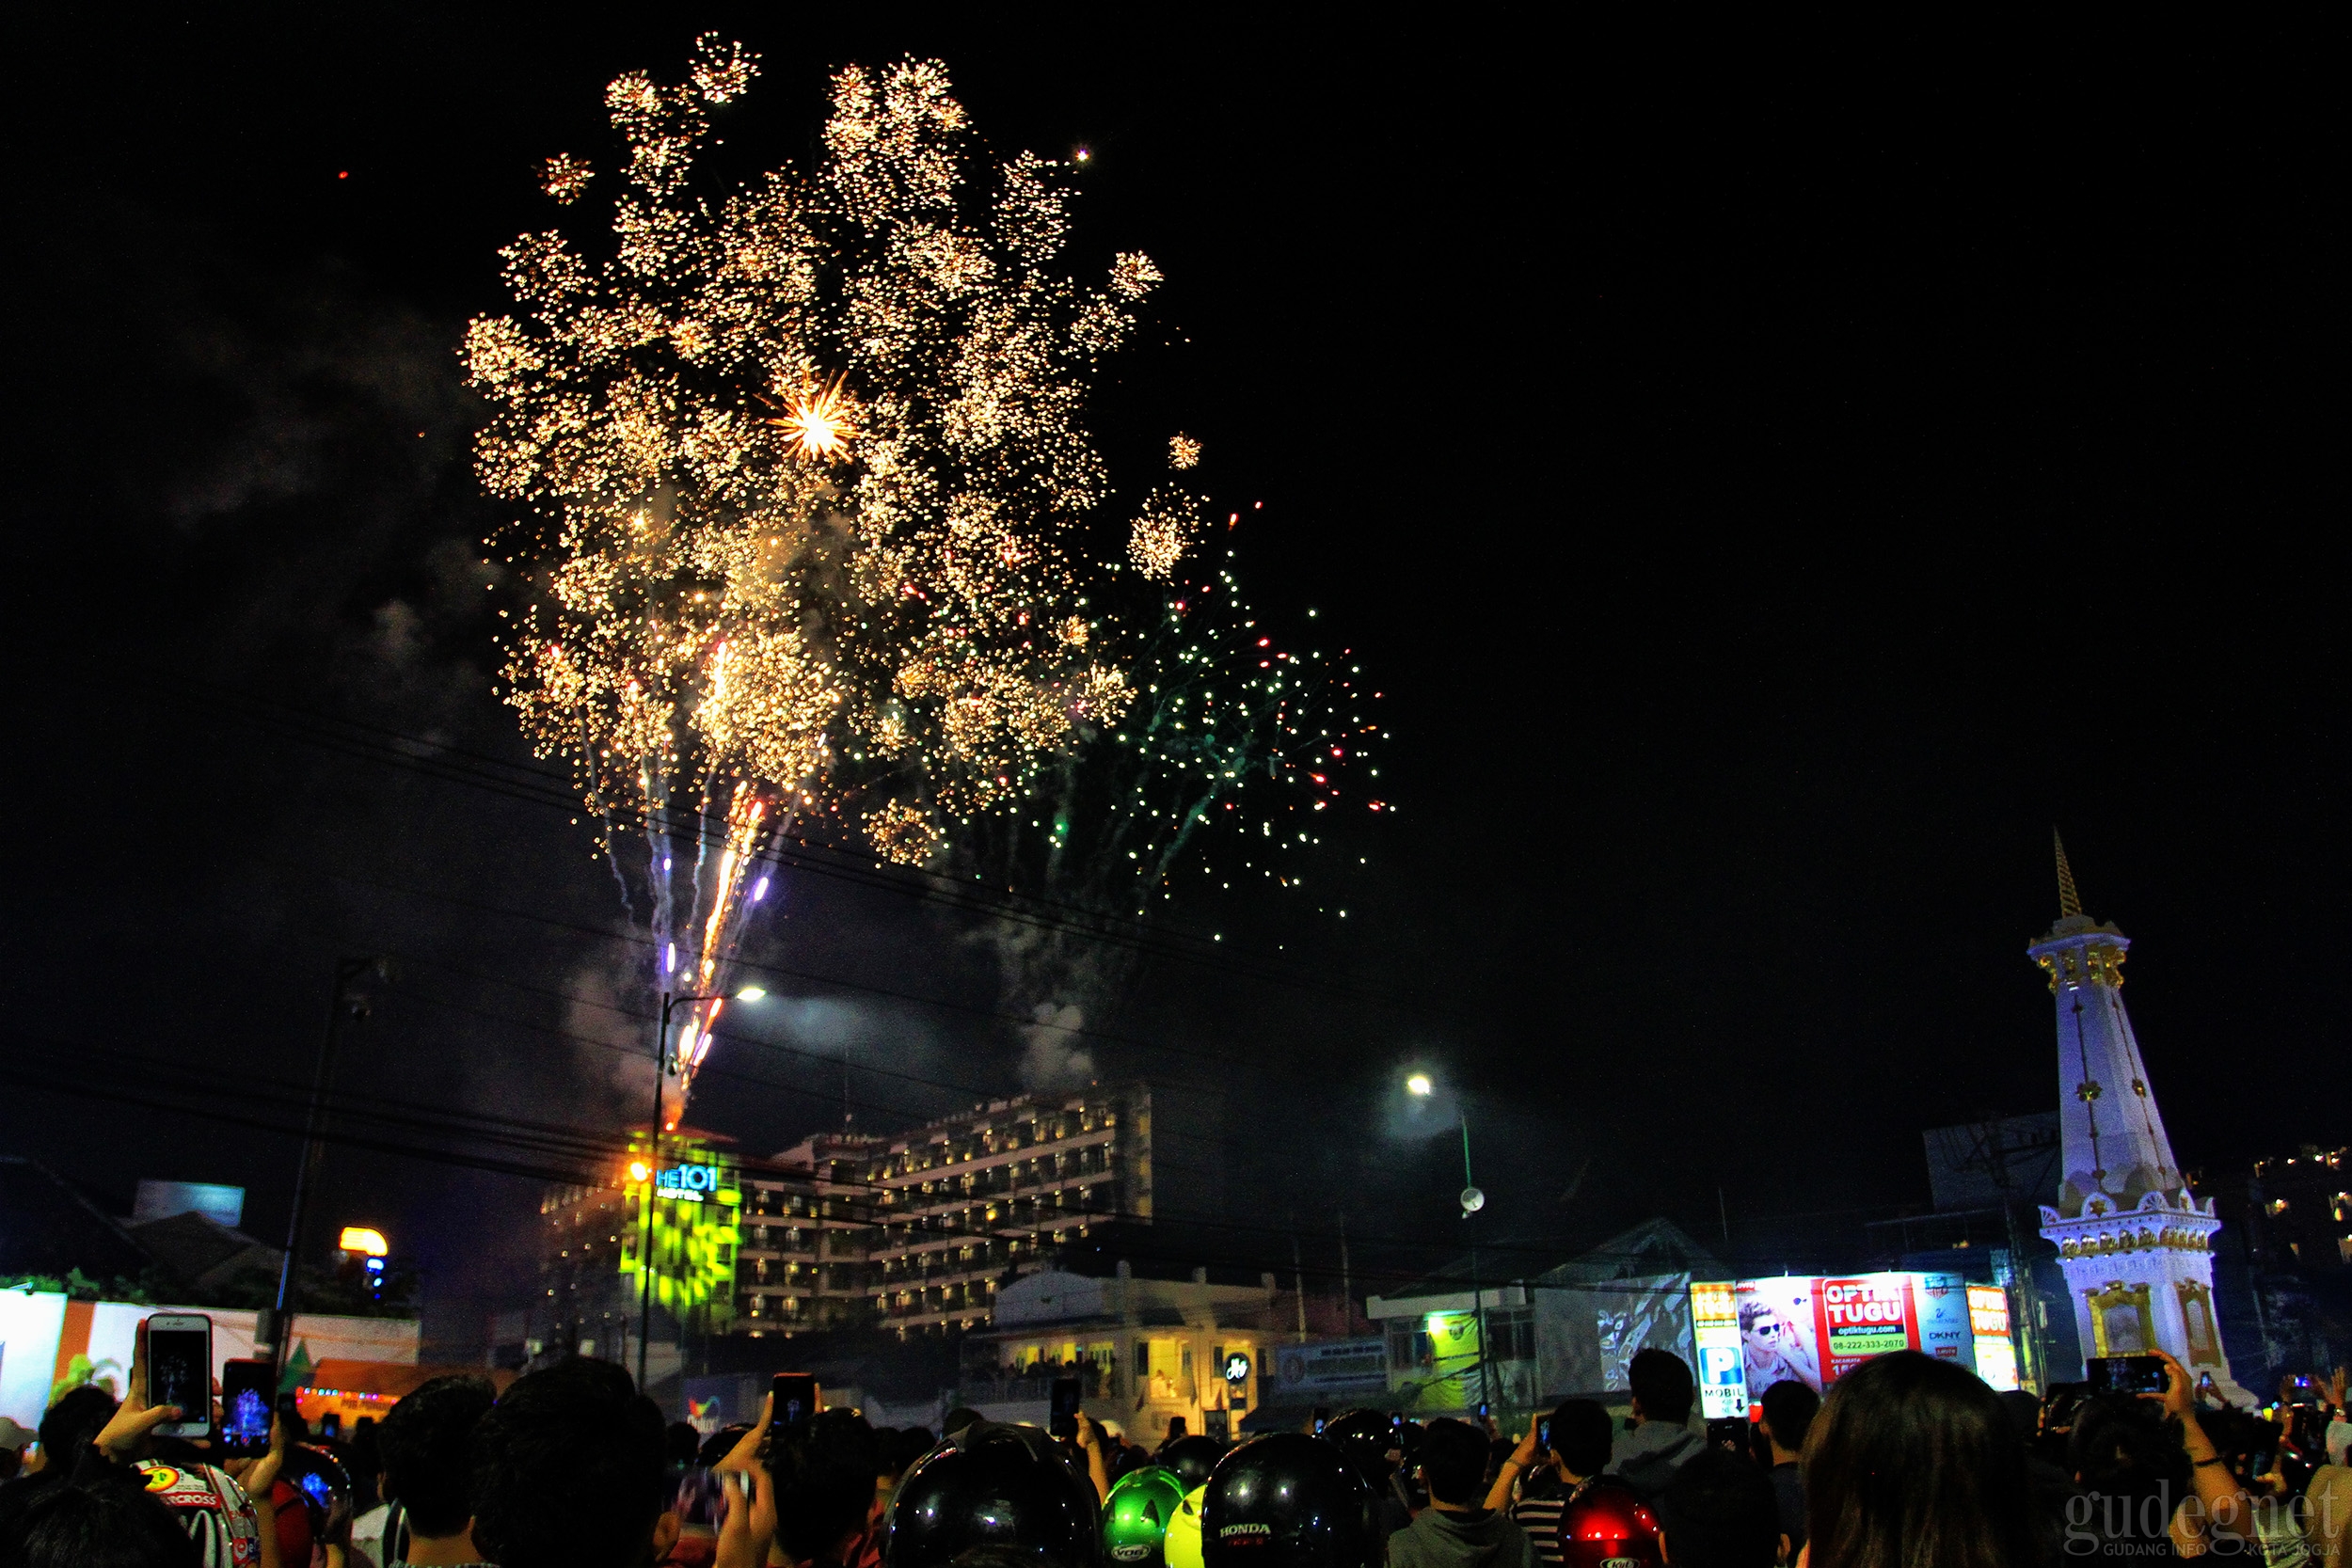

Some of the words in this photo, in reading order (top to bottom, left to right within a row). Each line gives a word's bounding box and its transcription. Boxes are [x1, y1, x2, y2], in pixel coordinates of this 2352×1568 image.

[1828, 1301, 1901, 1323] TUGU
[1971, 1308, 2007, 1332] TUGU
[1837, 1325, 1897, 1337] optiktugu.com
[1929, 1331, 1960, 1339] DKNY
[1833, 1339, 1904, 1350] 08-222-333-2070
[1706, 1348, 1735, 1384] P
[1705, 1388, 1744, 1397] MOBIL
[1219, 1523, 1271, 1538] HONDA
